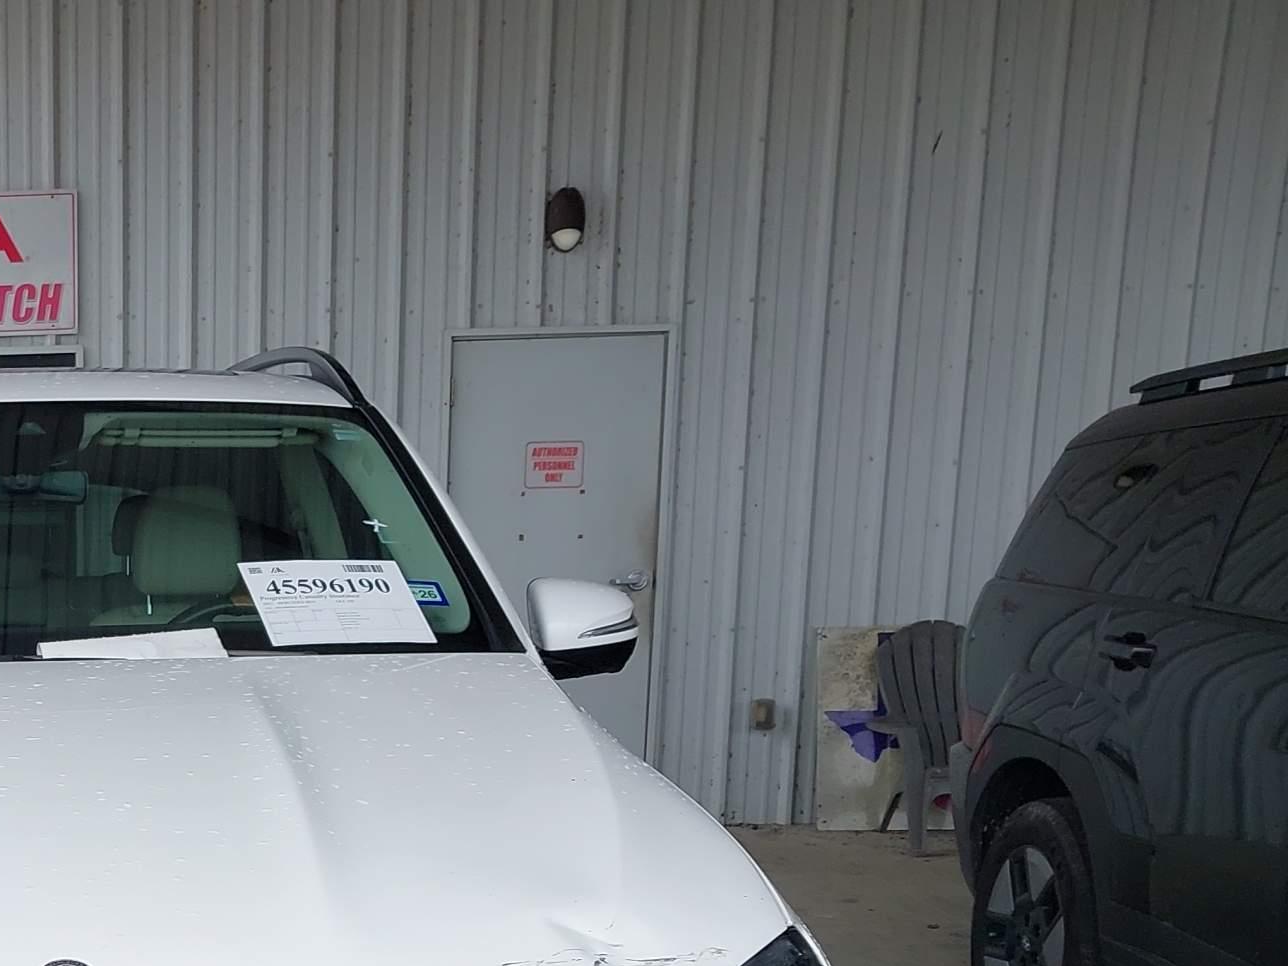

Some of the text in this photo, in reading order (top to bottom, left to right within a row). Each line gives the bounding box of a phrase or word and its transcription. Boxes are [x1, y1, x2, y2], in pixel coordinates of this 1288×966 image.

[532, 447, 578, 457] AUTHORIZED
[534, 461, 575, 470] PERSONNEL
[545, 473, 563, 482] ONLY
[266, 578, 391, 595] 45596190
